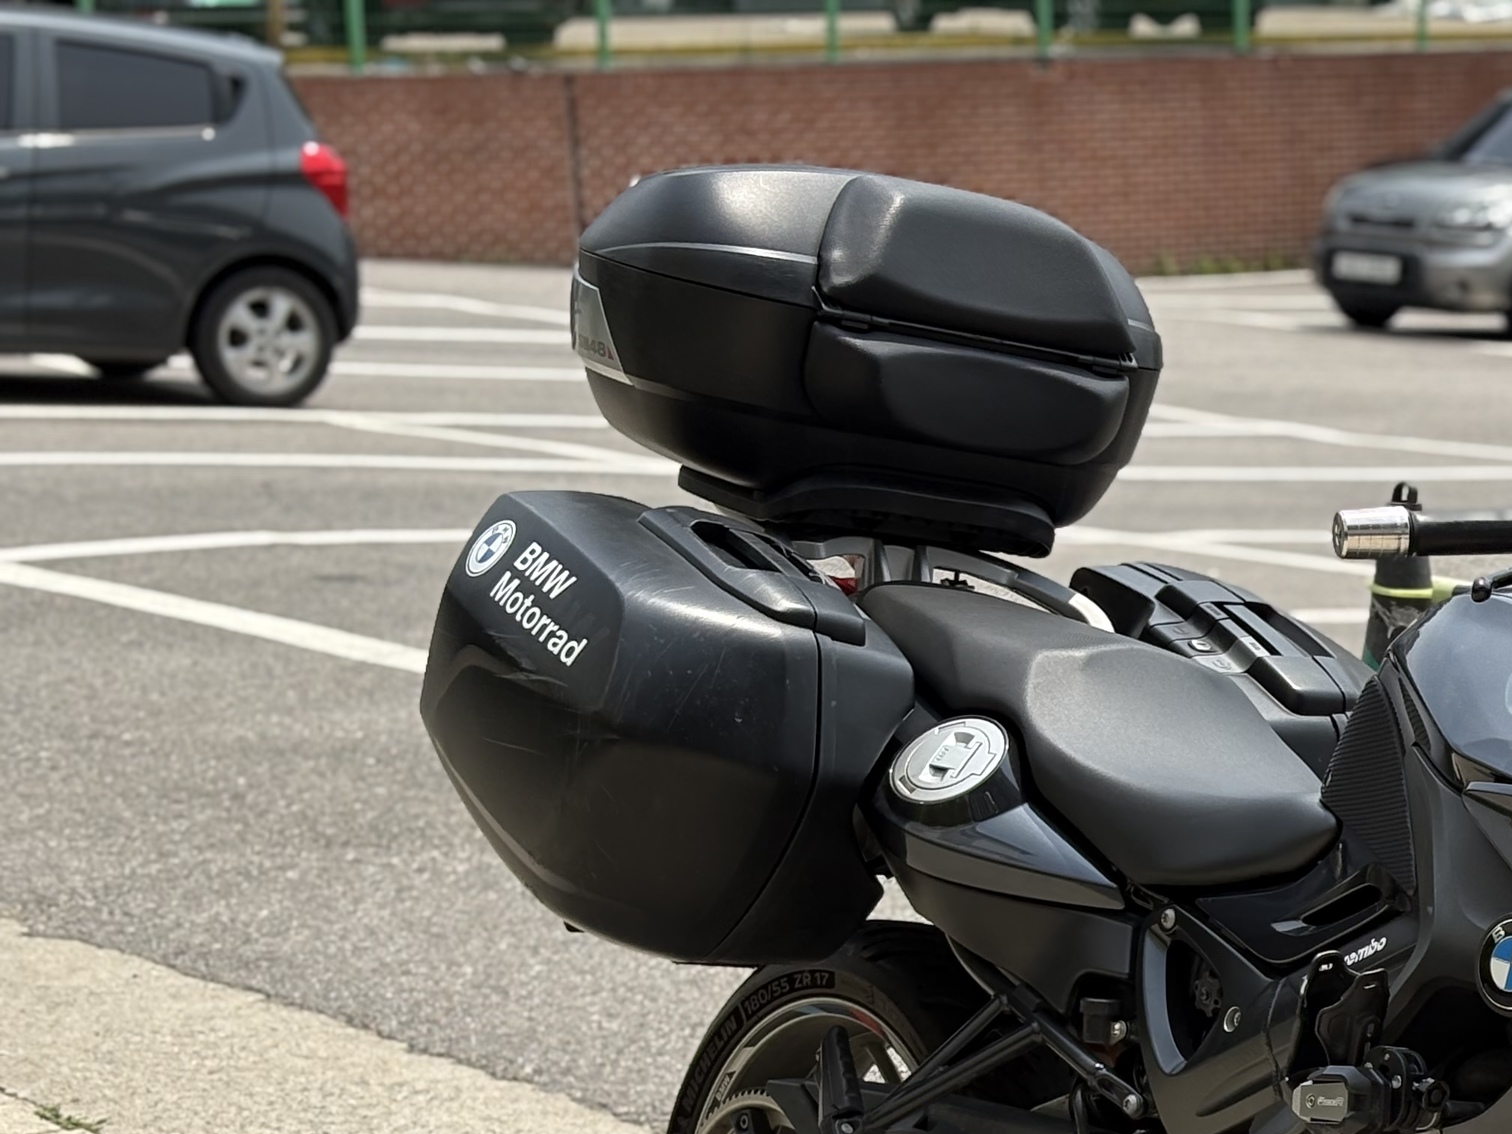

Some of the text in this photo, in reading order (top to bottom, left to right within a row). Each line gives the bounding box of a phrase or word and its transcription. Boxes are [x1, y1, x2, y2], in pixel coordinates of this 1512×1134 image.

[513, 541, 578, 600] BMW
[489, 570, 588, 667] Motorrad
[743, 977, 790, 1015] 180/55
[814, 972, 829, 986] 17
[681, 1014, 739, 1113] MICHELIN
